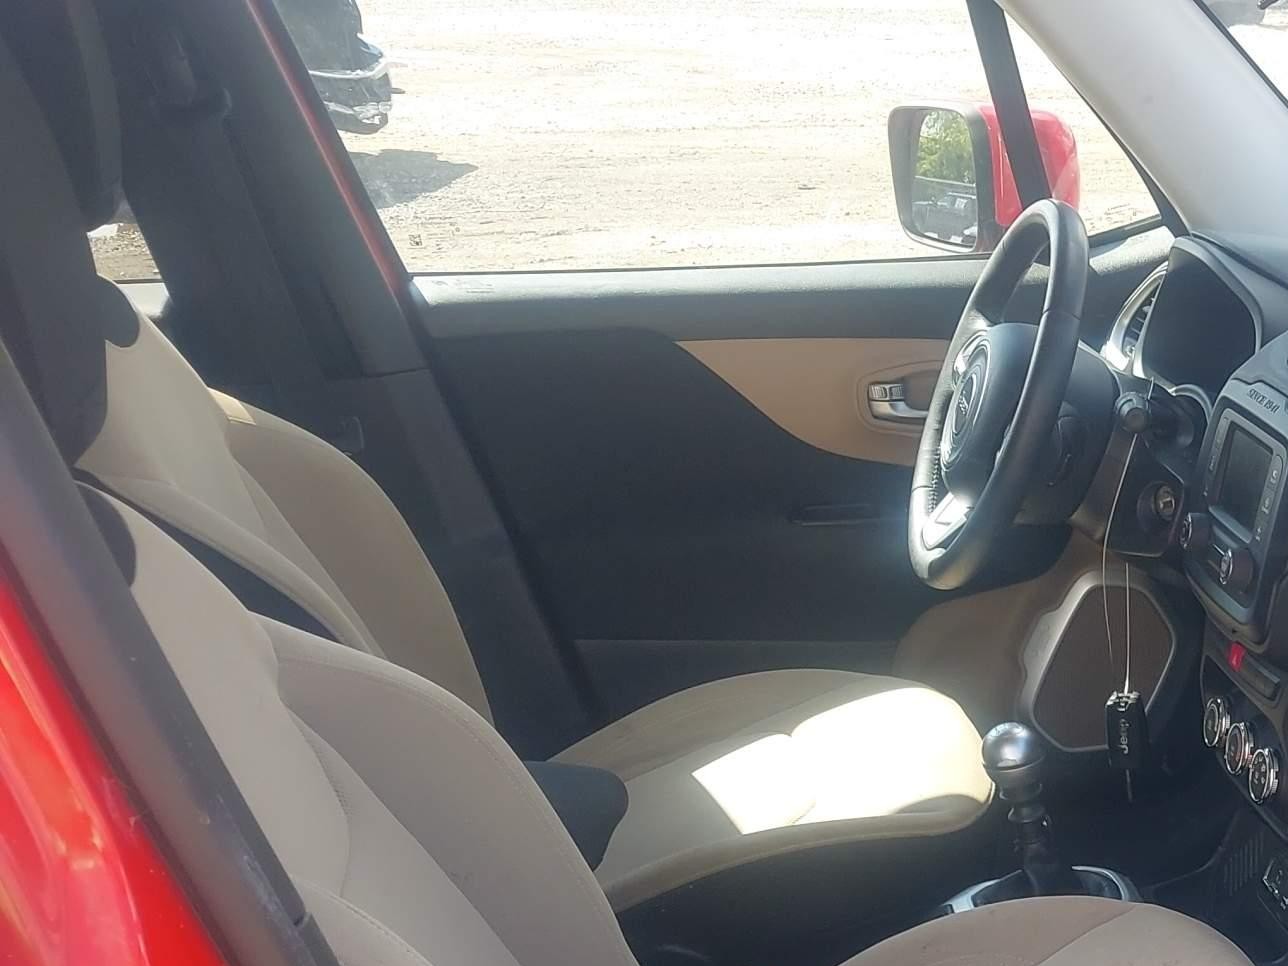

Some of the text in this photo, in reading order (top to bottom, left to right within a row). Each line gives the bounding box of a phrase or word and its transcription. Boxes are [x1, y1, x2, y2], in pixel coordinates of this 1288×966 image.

[1248, 388, 1281, 414] SINCE 1941
[1119, 718, 1130, 754] Jeep
